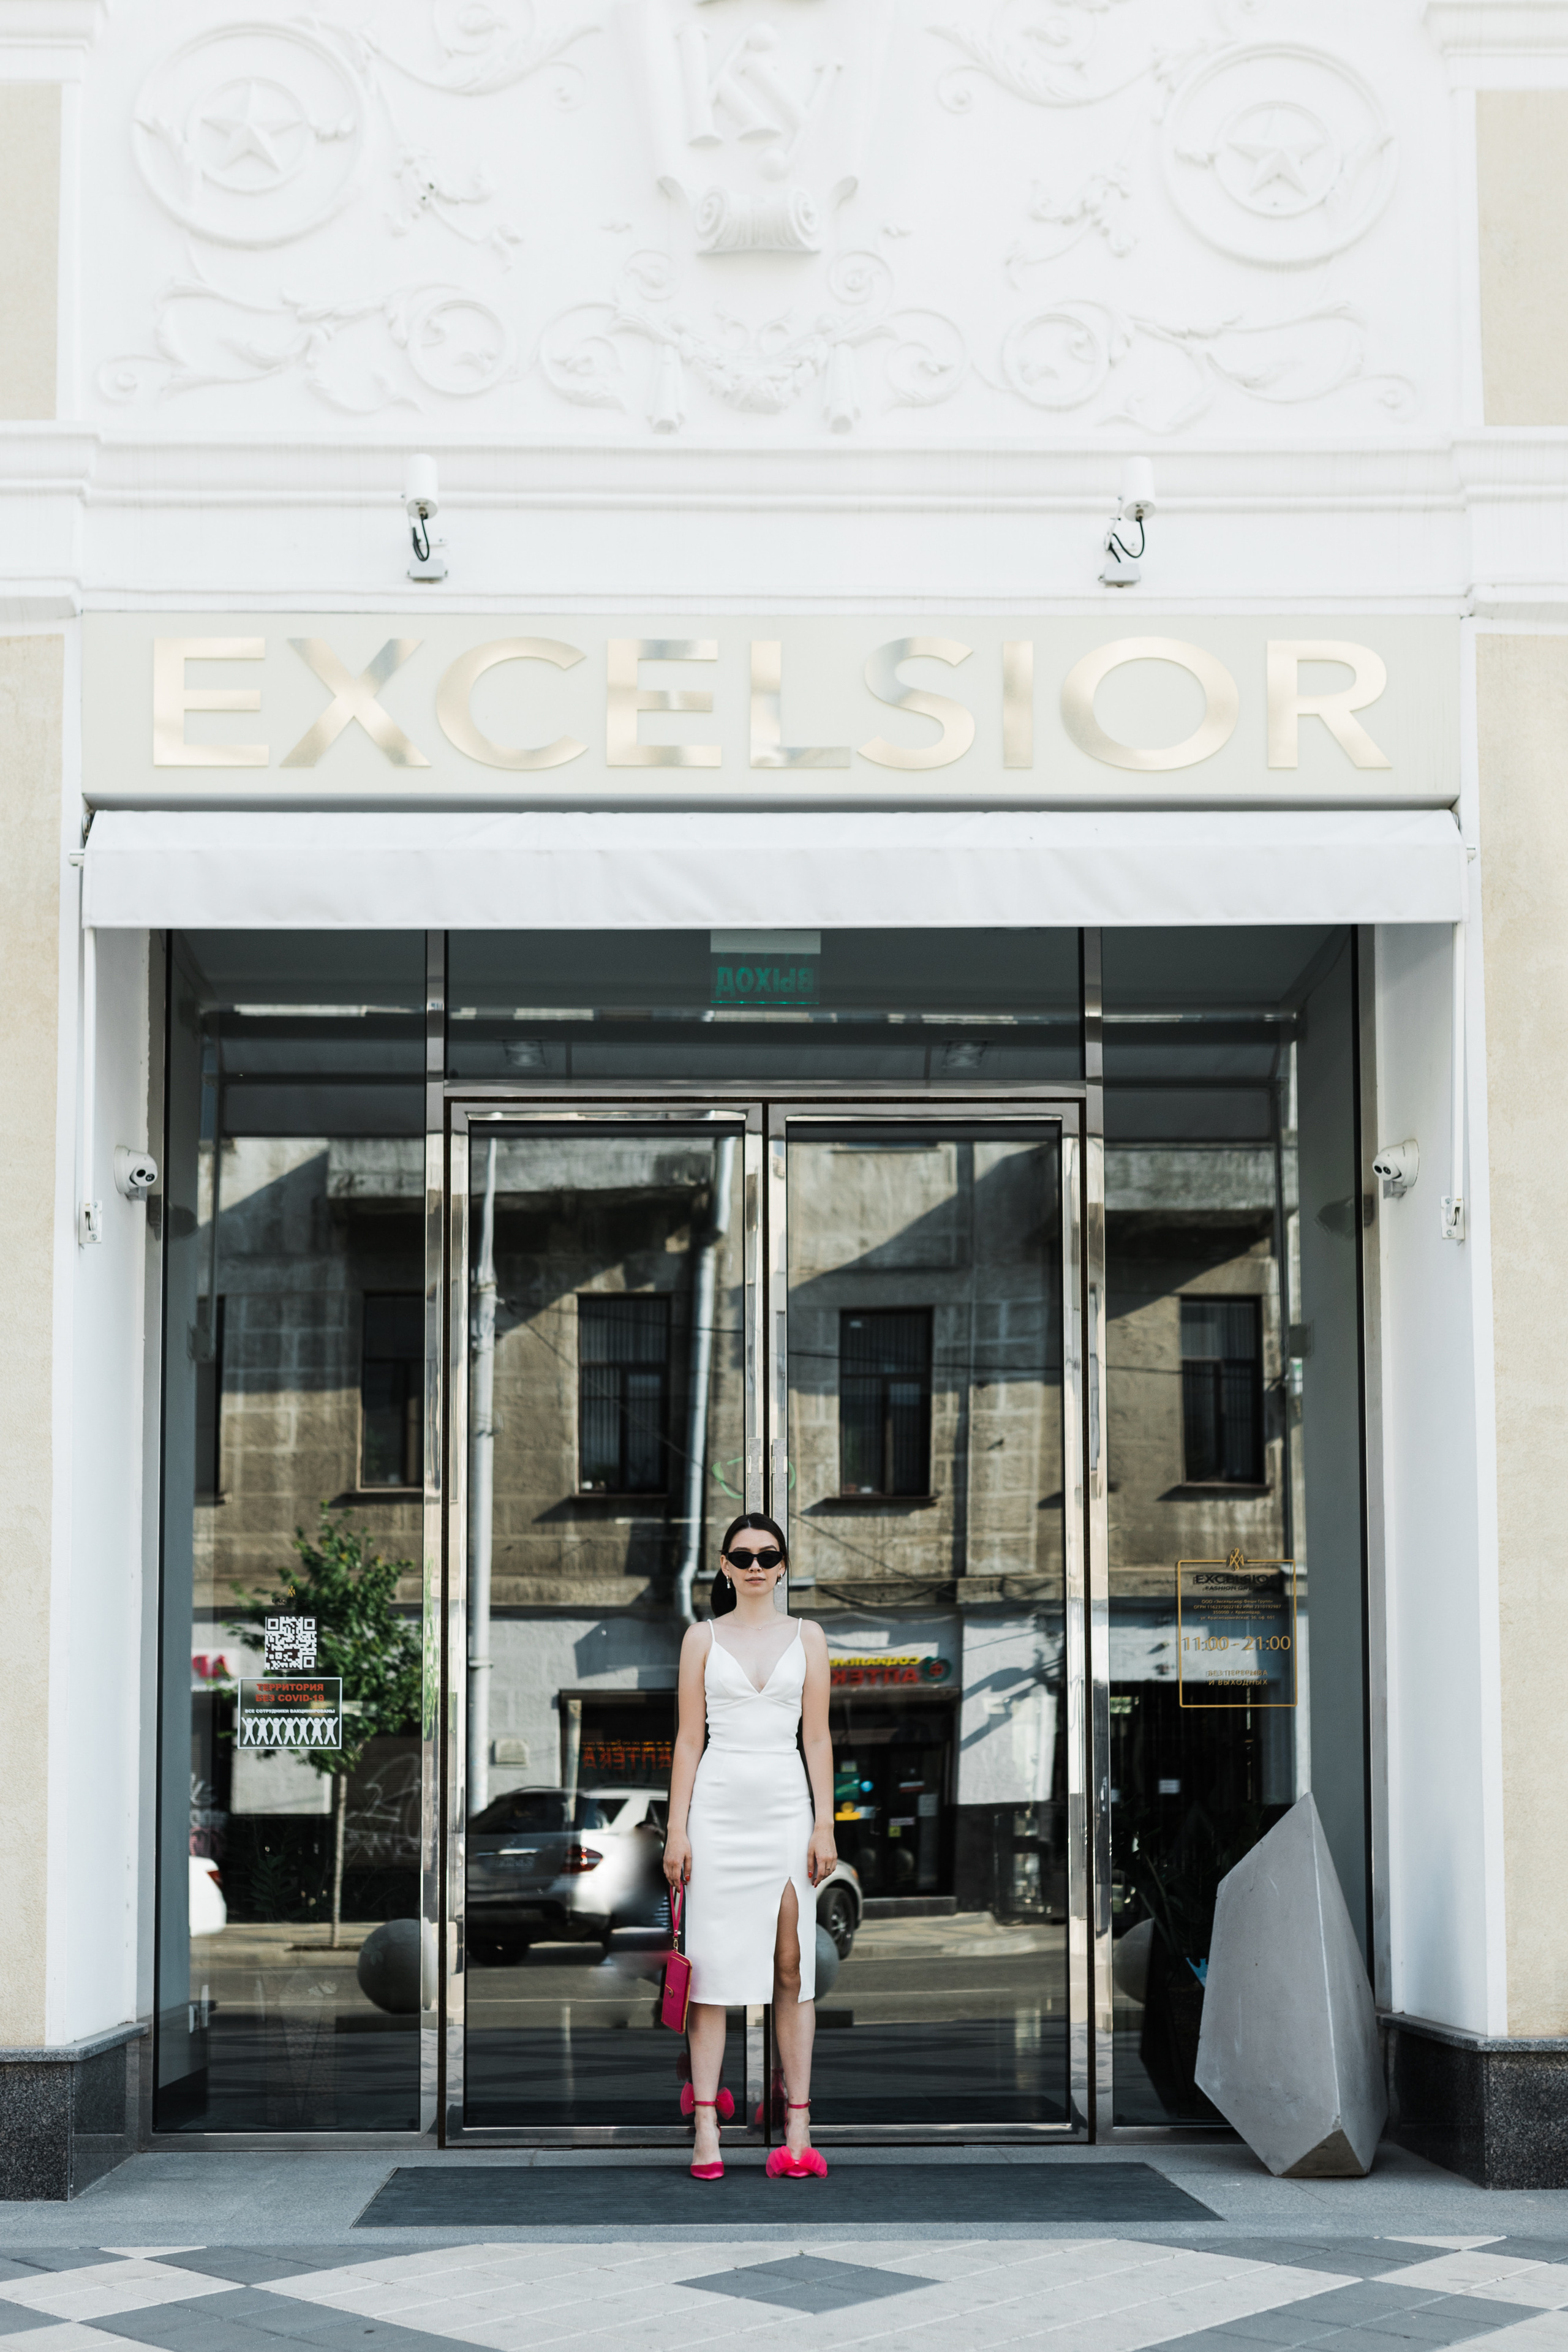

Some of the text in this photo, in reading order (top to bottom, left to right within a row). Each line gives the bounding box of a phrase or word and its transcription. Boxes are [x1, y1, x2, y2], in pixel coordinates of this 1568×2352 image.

[153, 636, 1393, 771] EXCELSIOR
[1183, 1636, 1229, 1651] 11:00
[1244, 1635, 1291, 1651] 21:00
